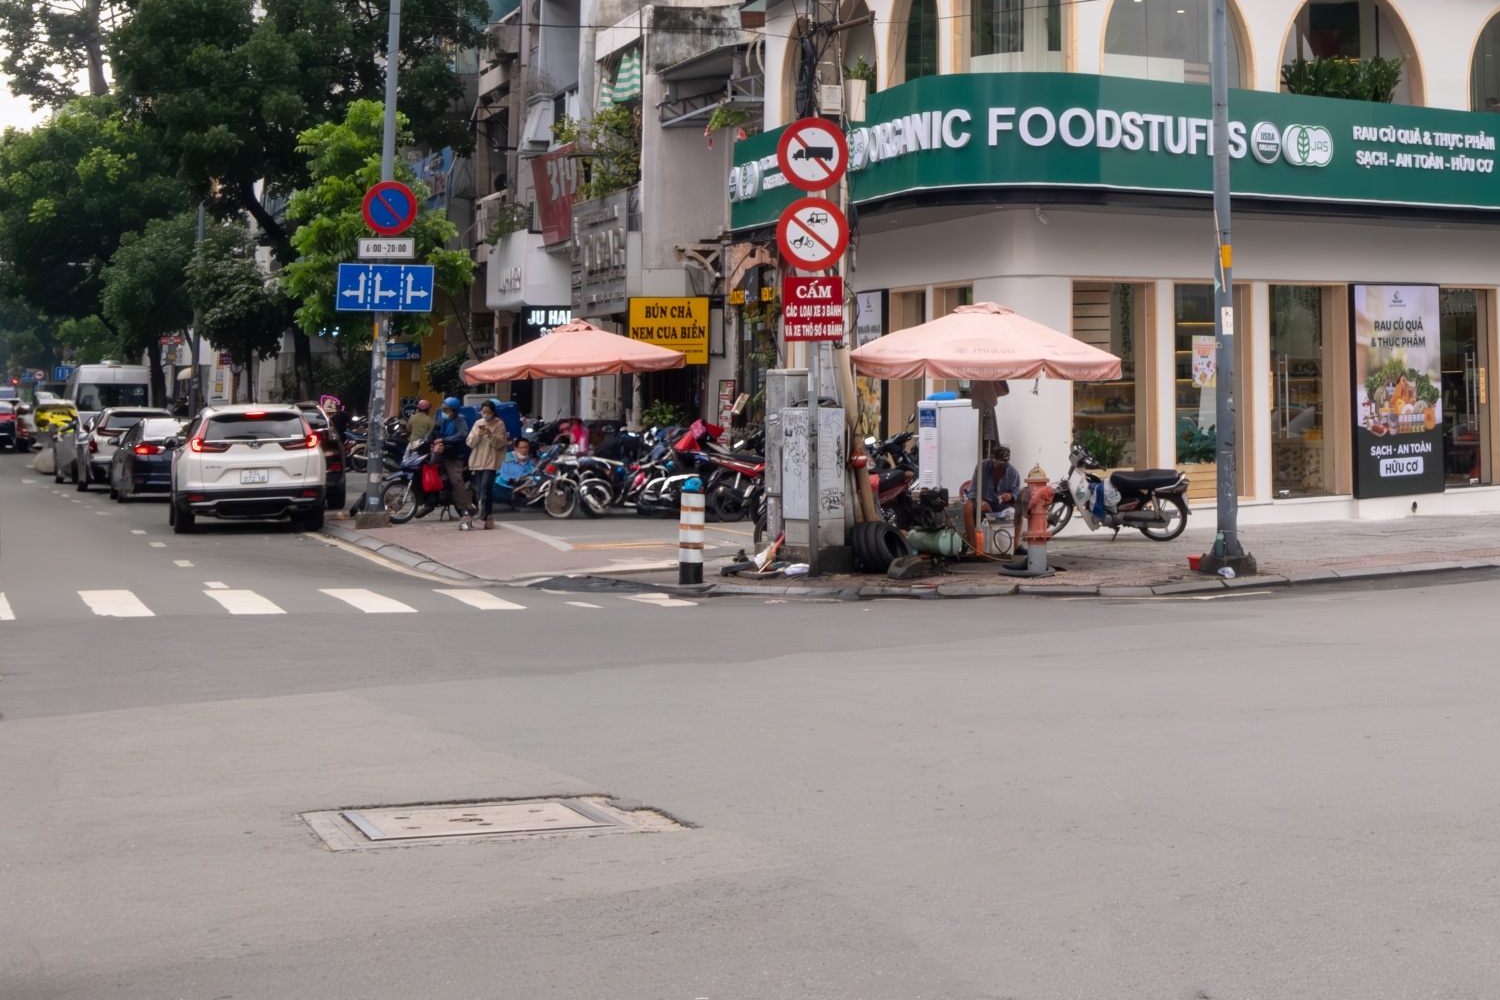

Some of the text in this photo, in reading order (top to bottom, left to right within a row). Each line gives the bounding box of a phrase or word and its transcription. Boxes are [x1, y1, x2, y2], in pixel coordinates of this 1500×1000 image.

[868, 108, 972, 163] ORGANIC
[1260, 132, 1276, 142] USDA
[1353, 124, 1495, 150] RAU CỦ QUẢ & THỰC PHẨM
[1311, 140, 1329, 152] JAS
[1356, 151, 1387, 168] SẠCH
[1396, 153, 1412, 168] AN
[1414, 153, 1444, 171] TOÀN
[1451, 155, 1479, 172] HỮU
[1480, 157, 1494, 173] CƠ
[795, 279, 832, 299] CẤM
[527, 310, 546, 325] JU
[645, 301, 693, 319] BÚN CHẢ
[785, 301, 842, 320] CÁC LOẠI XE 3 BÁNH
[631, 319, 706, 339] NEM CUA BIỂN
[785, 321, 793, 336] VÀ
[793, 324, 801, 336] XE
[823, 324, 827, 336] 4
[827, 320, 843, 336] BÁNH
[1374, 316, 1424, 332] RAU CỦ QUẢ
[1371, 332, 1426, 351] & THỰC PHẨM
[1370, 444, 1393, 459] SẠCH
[1397, 443, 1409, 454] AN
[1410, 440, 1432, 454] TOÀN
[1385, 459, 1419, 474] HỮU CƠ
